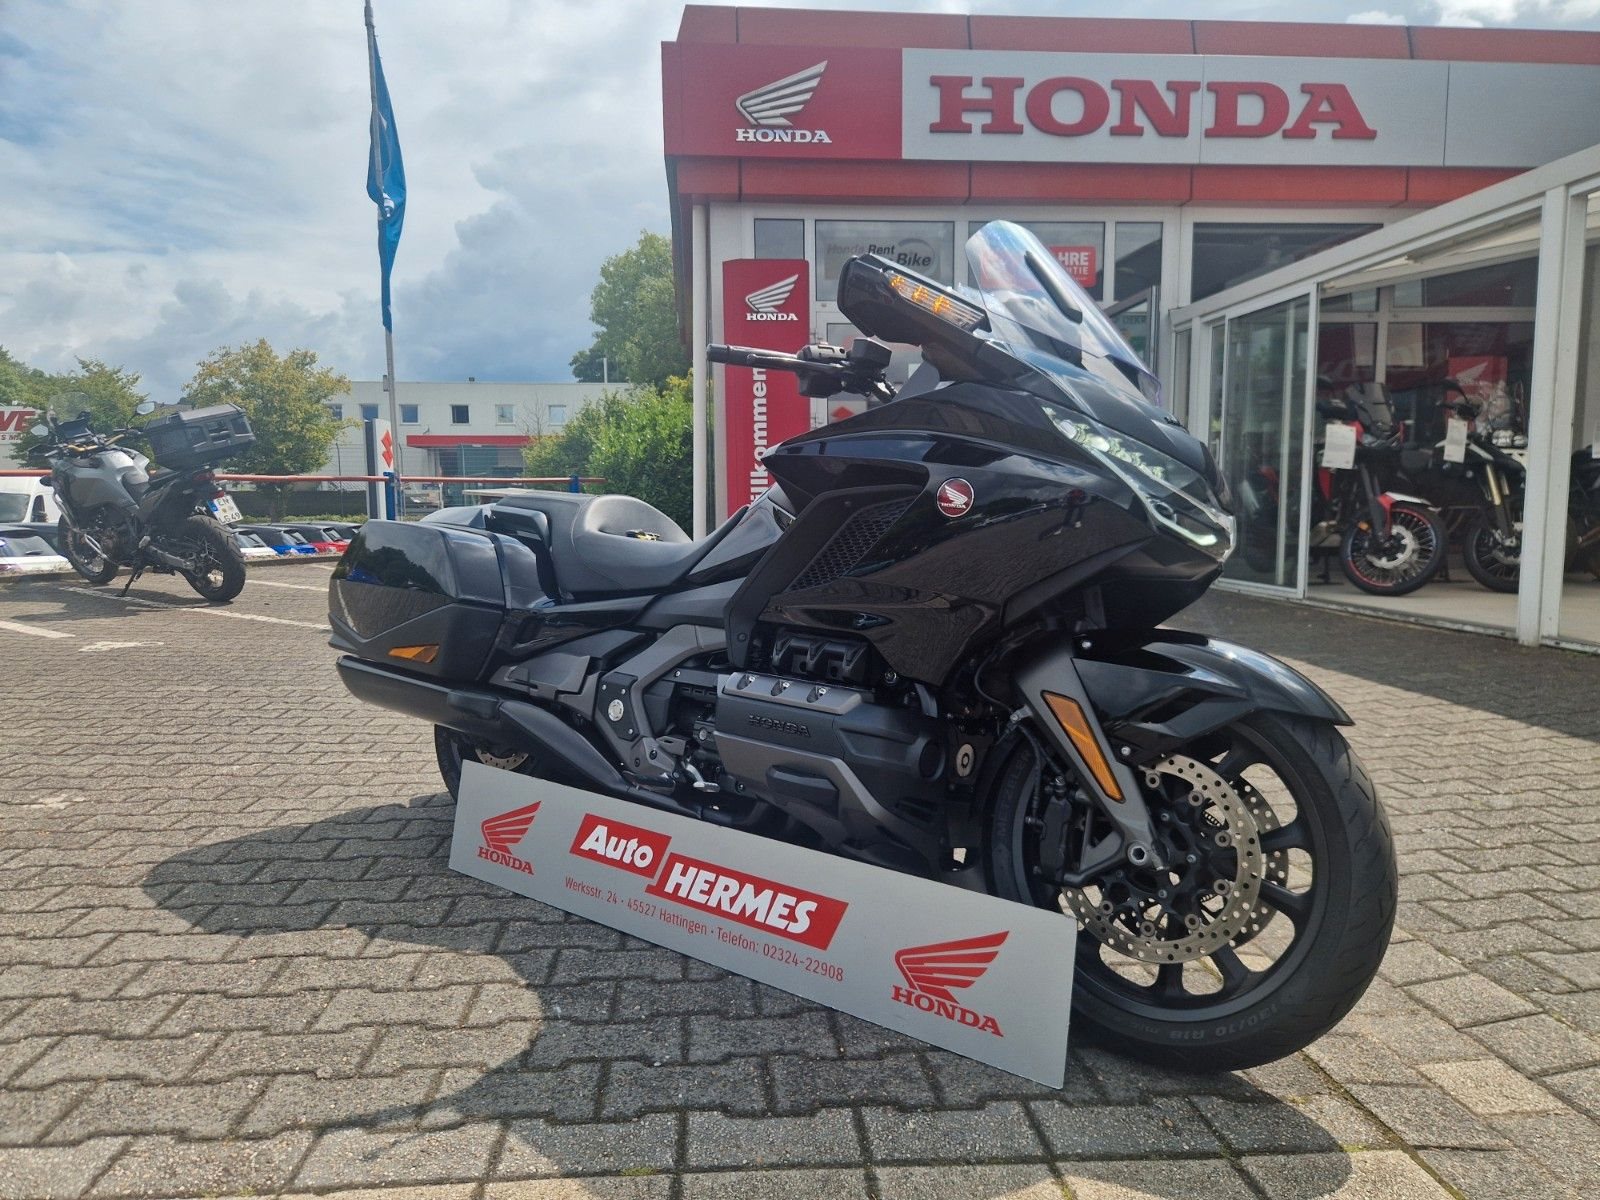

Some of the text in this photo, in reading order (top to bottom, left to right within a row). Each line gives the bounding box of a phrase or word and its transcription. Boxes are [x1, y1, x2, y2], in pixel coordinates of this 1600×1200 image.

[929, 75, 1378, 140] HONDA
[735, 127, 833, 145] HONDA
[868, 244, 896, 255] Rent
[896, 252, 932, 267] Bike
[746, 312, 798, 321] HONDA
[750, 367, 768, 504] illkommen
[748, 713, 811, 737] HONDA
[477, 846, 535, 876] HONDA
[580, 824, 654, 868] Auto
[663, 862, 818, 934] HERMES
[565, 876, 844, 982] Werksstr. 24 45527 Hattingen Telefon: 02324-22908
[891, 984, 1004, 1037] HONDA
